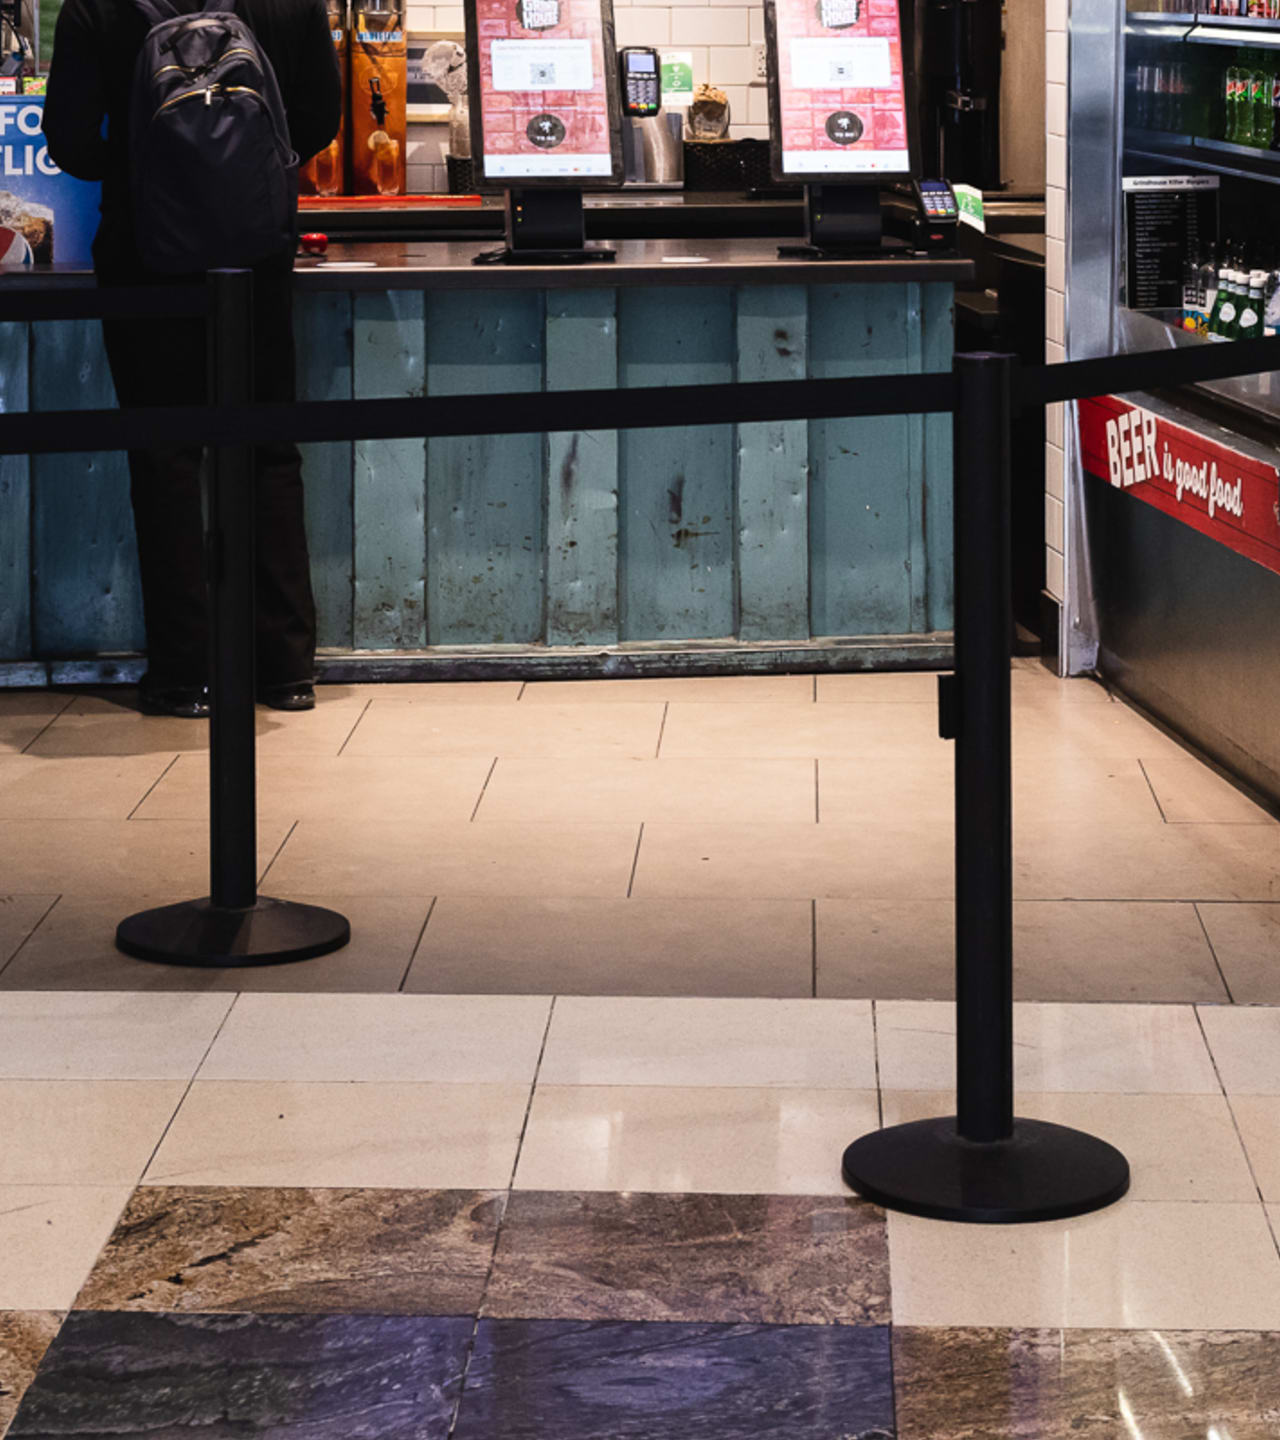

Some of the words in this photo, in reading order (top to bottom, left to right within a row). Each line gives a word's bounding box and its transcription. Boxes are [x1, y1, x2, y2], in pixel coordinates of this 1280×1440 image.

[1105, 407, 1160, 489] BEER
[1162, 441, 1175, 483] is
[1175, 457, 1209, 503] good
[1208, 461, 1244, 520] food
